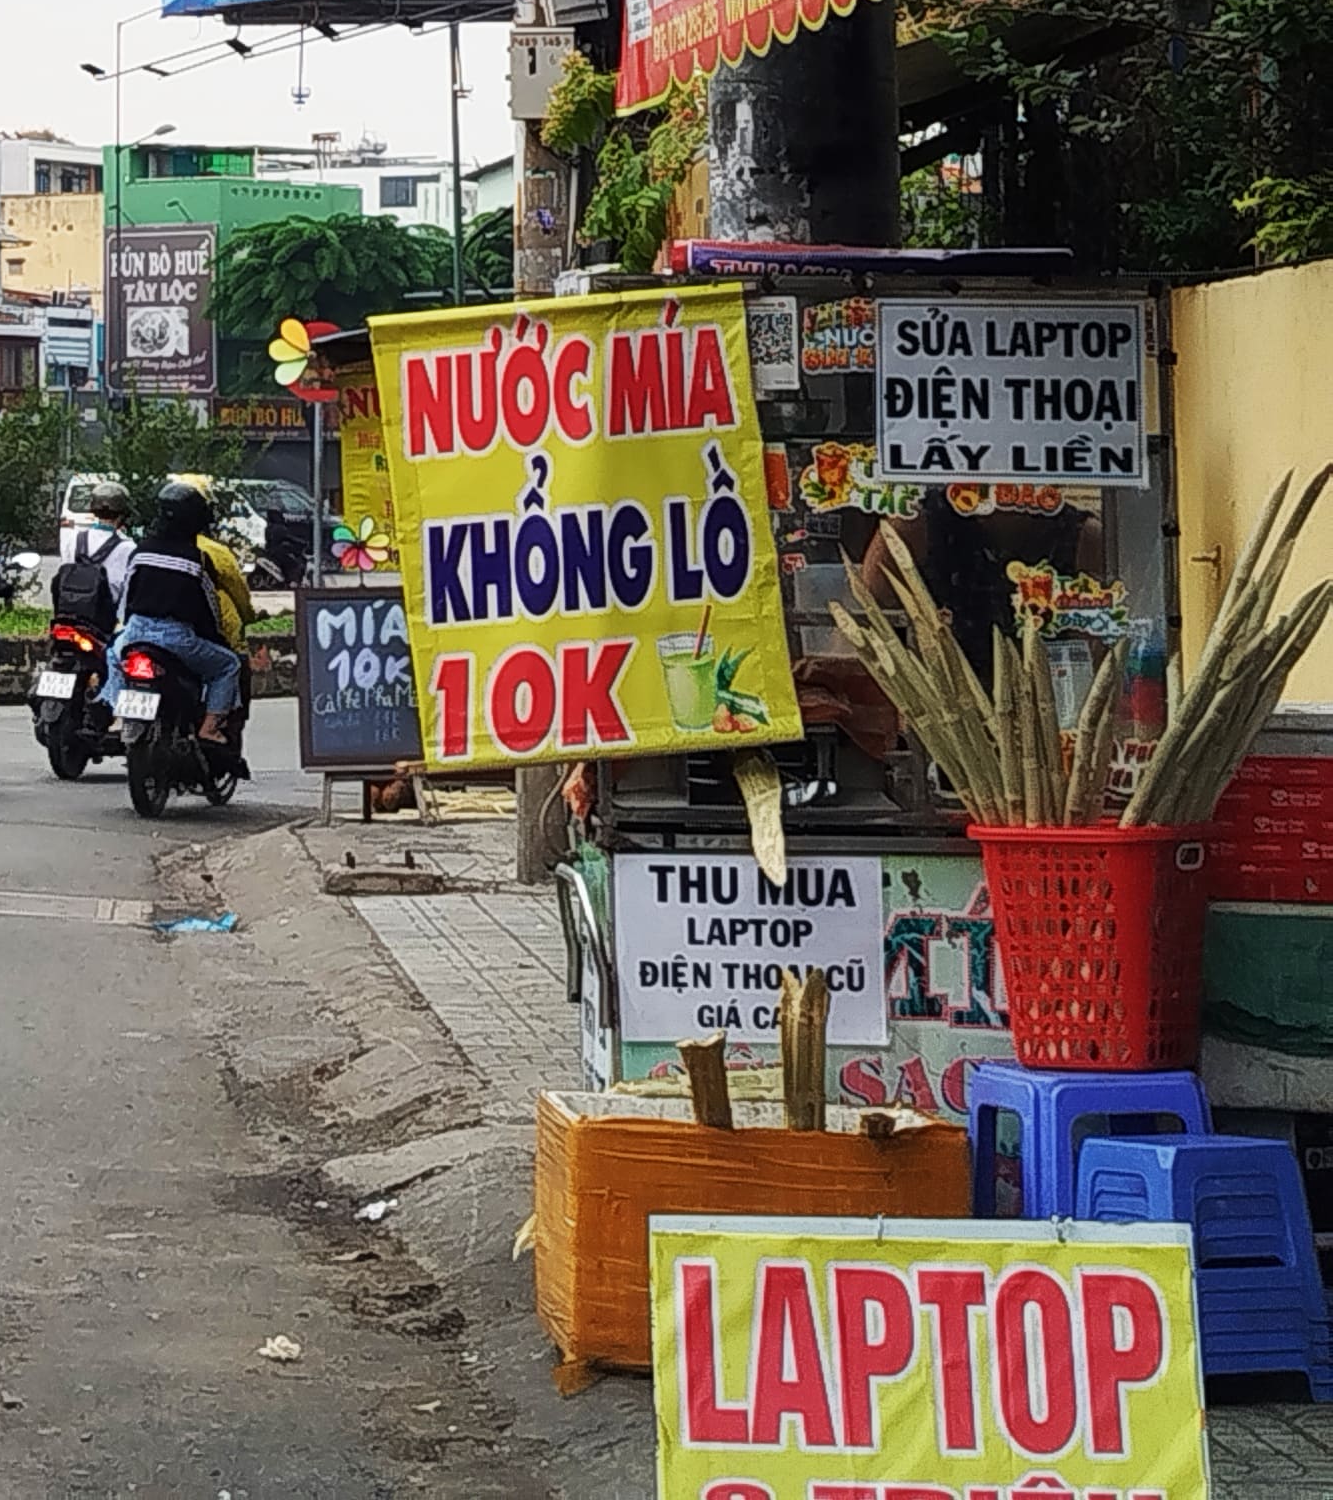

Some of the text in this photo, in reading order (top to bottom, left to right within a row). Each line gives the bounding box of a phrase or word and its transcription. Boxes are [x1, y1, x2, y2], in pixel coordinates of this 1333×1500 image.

[148, 244, 172, 276] BÒ
[174, 239, 210, 276] HUẾ
[122, 280, 197, 305] TÂY LỘC
[896, 307, 973, 358] SỬA
[986, 319, 1132, 359] LAPTOP
[406, 300, 735, 457] NƯỚC MÍA
[884, 366, 1138, 431] ĐIỆN THOẠI
[889, 432, 1134, 474] LẤY LIỀN
[429, 445, 750, 624] KHỔNG LỒ
[316, 599, 410, 650] MÍA
[327, 647, 412, 691] 10K
[436, 641, 634, 757] 10K
[648, 864, 857, 908] THU MUA
[686, 916, 814, 949] LAPTOP
[638, 954, 713, 995] ĐIỆN
[826, 958, 865, 992] CŨ
[697, 999, 742, 1029] GIÁ
[680, 1262, 1164, 1456] LAPTOP
